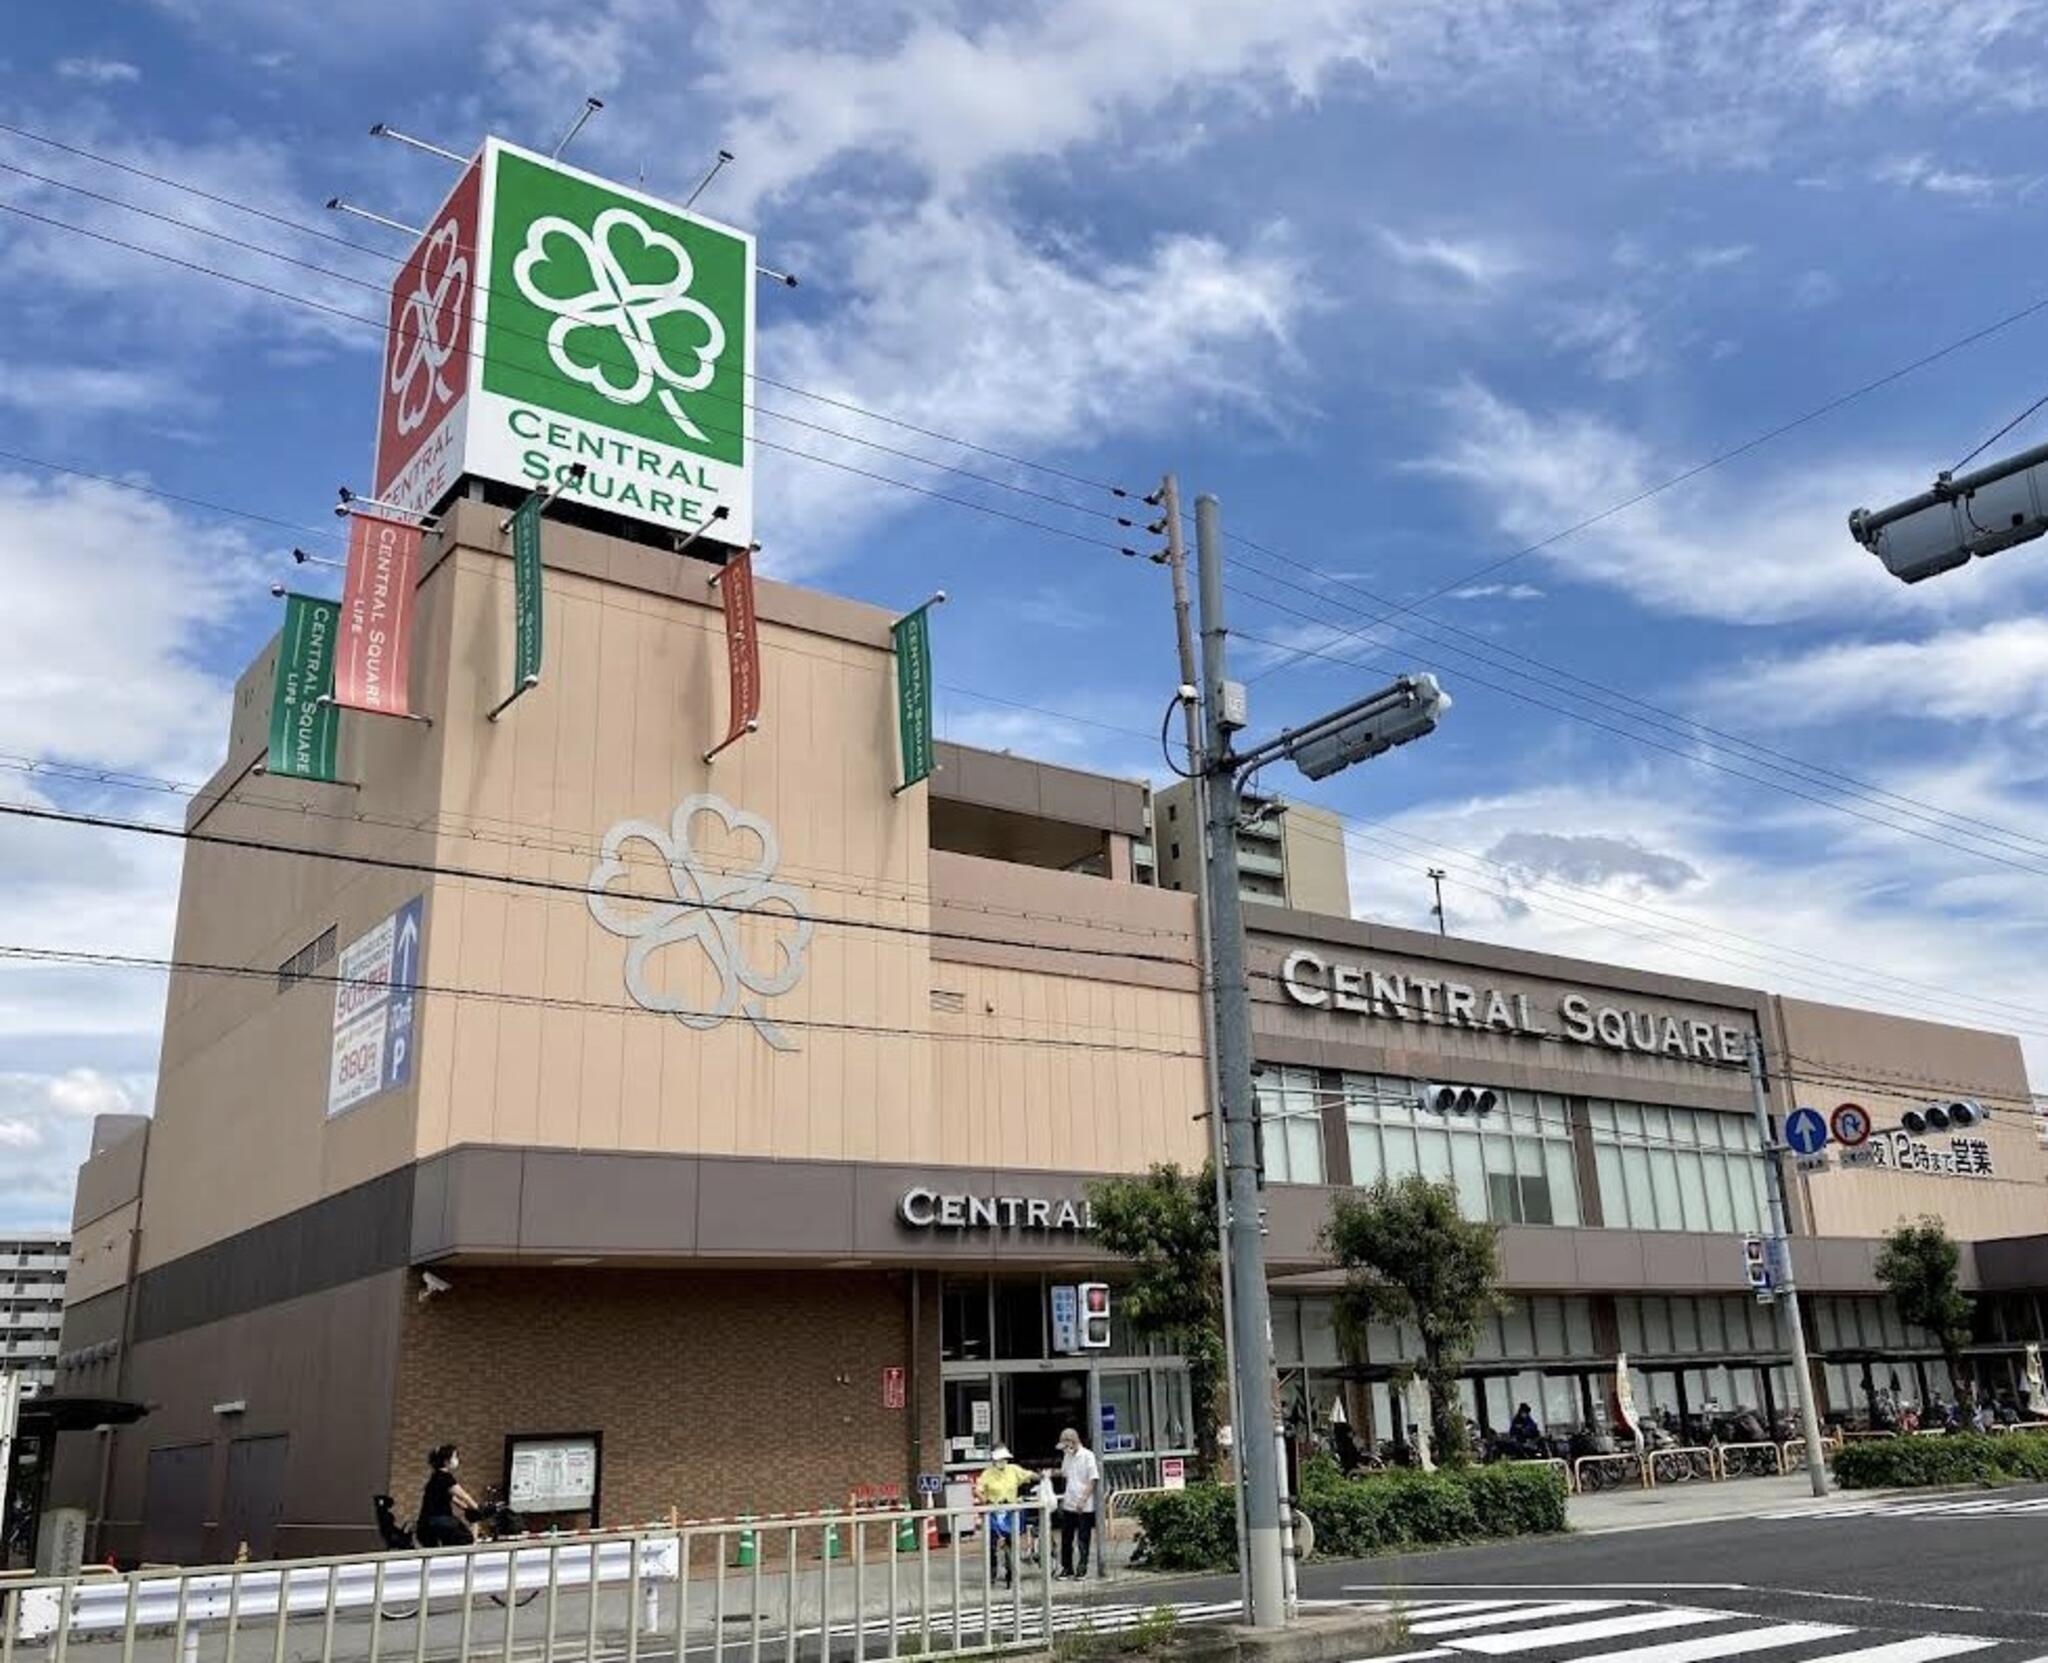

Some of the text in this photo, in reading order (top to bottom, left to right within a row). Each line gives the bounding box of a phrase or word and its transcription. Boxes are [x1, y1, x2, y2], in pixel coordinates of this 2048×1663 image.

[508, 409, 719, 493] CENTRAL
[522, 450, 702, 525] SQUARE
[351, 599, 365, 633] LIFE
[366, 527, 397, 707] CENTRAL SQUARE
[296, 606, 330, 774] CENTRAL SQUARE
[1282, 951, 1749, 1064] CENTRAL SQUARE
[903, 1187, 1100, 1229] CENTRAL
